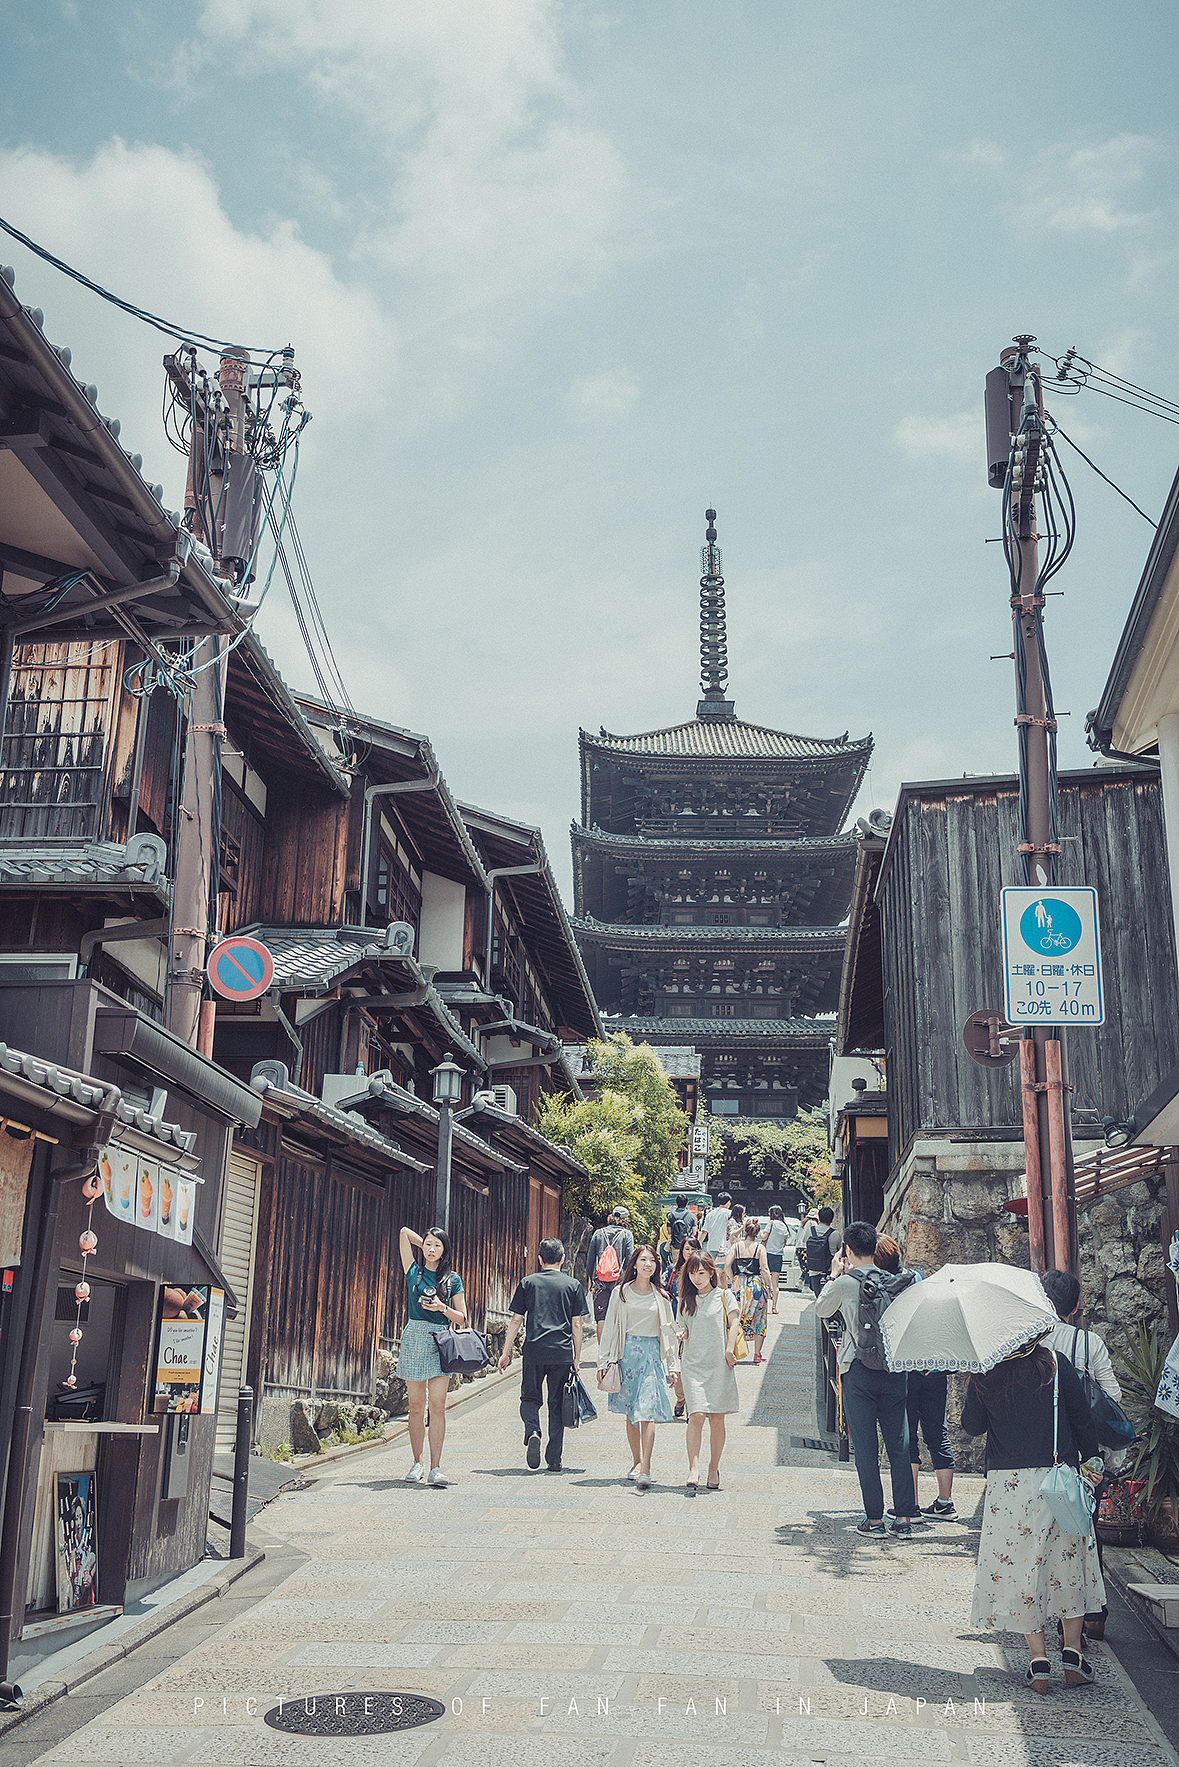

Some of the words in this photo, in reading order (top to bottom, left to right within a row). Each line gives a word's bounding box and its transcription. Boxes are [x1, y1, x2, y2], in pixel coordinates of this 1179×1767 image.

[1011, 963, 1095, 977] 土曜・日曜・休日
[1025, 980, 1083, 997] 10-17
[1016, 1000, 1052, 1015] この先
[1059, 1000, 1095, 1016] 40m
[163, 1346, 188, 1364] Chae
